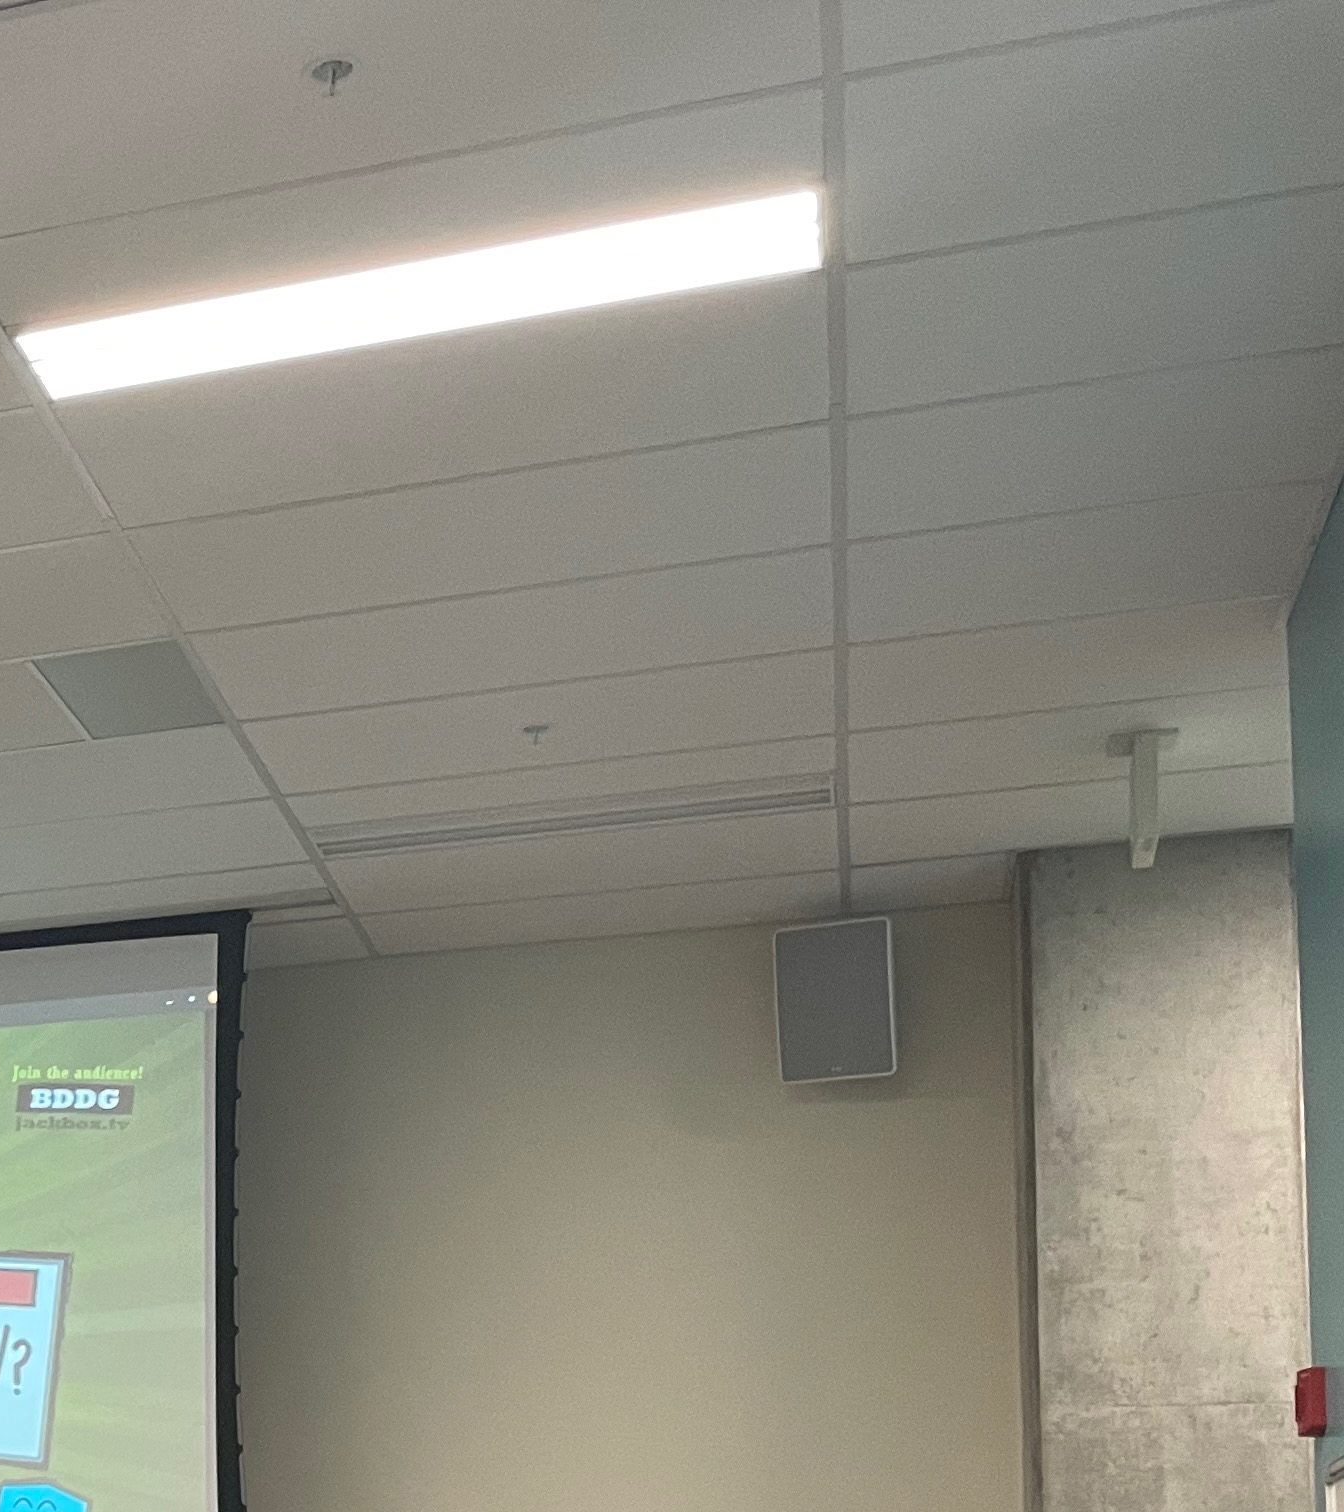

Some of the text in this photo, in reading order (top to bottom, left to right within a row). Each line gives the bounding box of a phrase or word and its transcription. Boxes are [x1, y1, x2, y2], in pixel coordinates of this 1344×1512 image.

[12, 1064, 144, 1082] Join the audience!
[30, 1088, 120, 1109] BDDG
[15, 1116, 130, 1131] jackbox.tv
